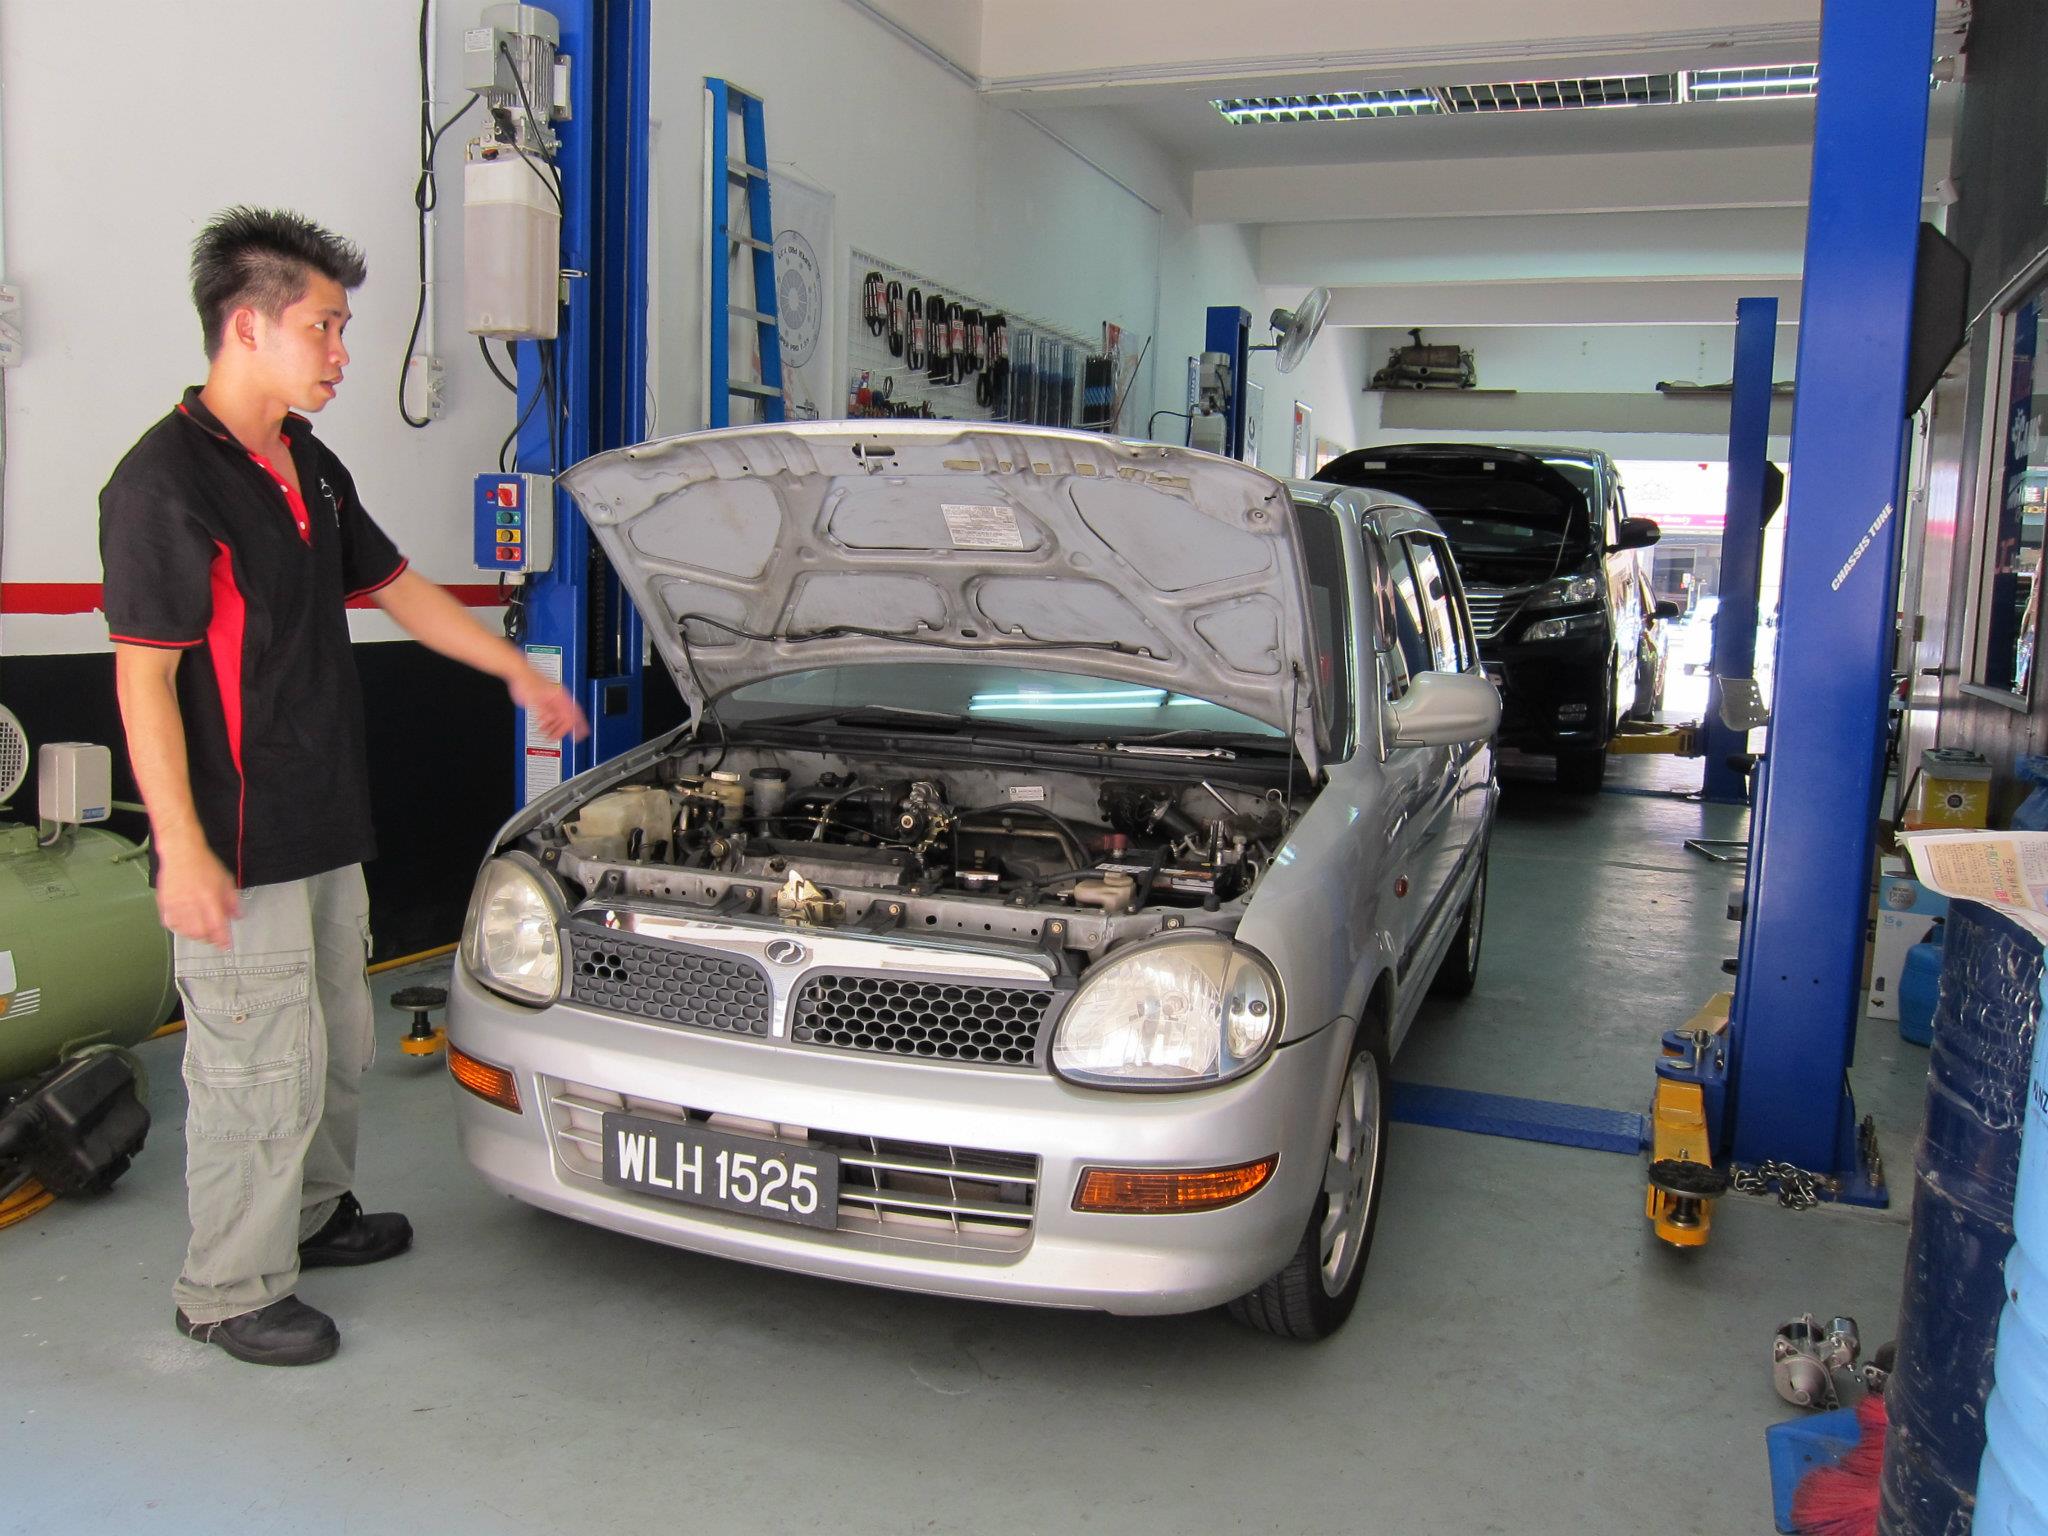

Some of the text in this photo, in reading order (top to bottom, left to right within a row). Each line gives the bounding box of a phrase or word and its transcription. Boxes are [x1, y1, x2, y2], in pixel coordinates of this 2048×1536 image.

[1831, 502, 1893, 591] CHASSIS TUNE
[617, 1130, 818, 1215] WLH 1525
